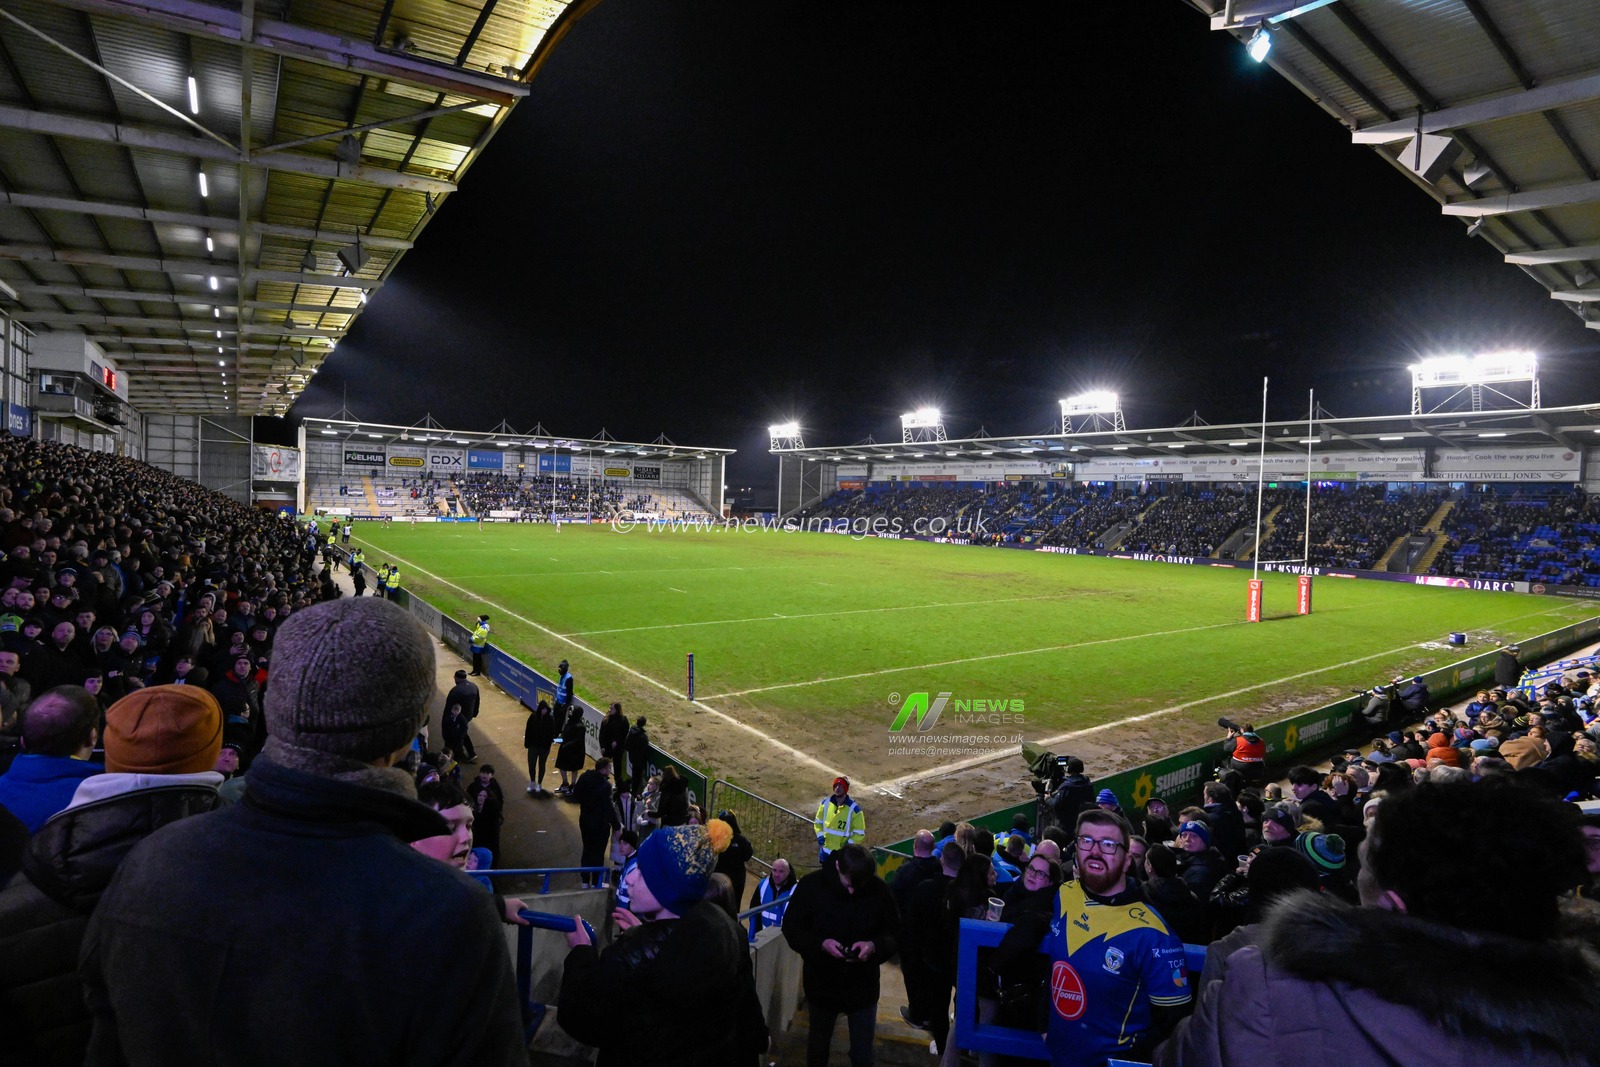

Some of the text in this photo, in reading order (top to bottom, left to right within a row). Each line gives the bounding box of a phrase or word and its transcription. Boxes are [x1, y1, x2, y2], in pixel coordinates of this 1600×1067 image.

[431, 456, 462, 466] CDX
[1512, 472, 1542, 480] JONES
[1042, 546, 1077, 555] MENSWEAR
[1134, 553, 1194, 564] MARC DARCY
[1299, 718, 1330, 741] SUNBELT
[1156, 762, 1202, 794] SUNBELT
[1161, 780, 1196, 798] RENTALS
[838, 820, 846, 830] 27
